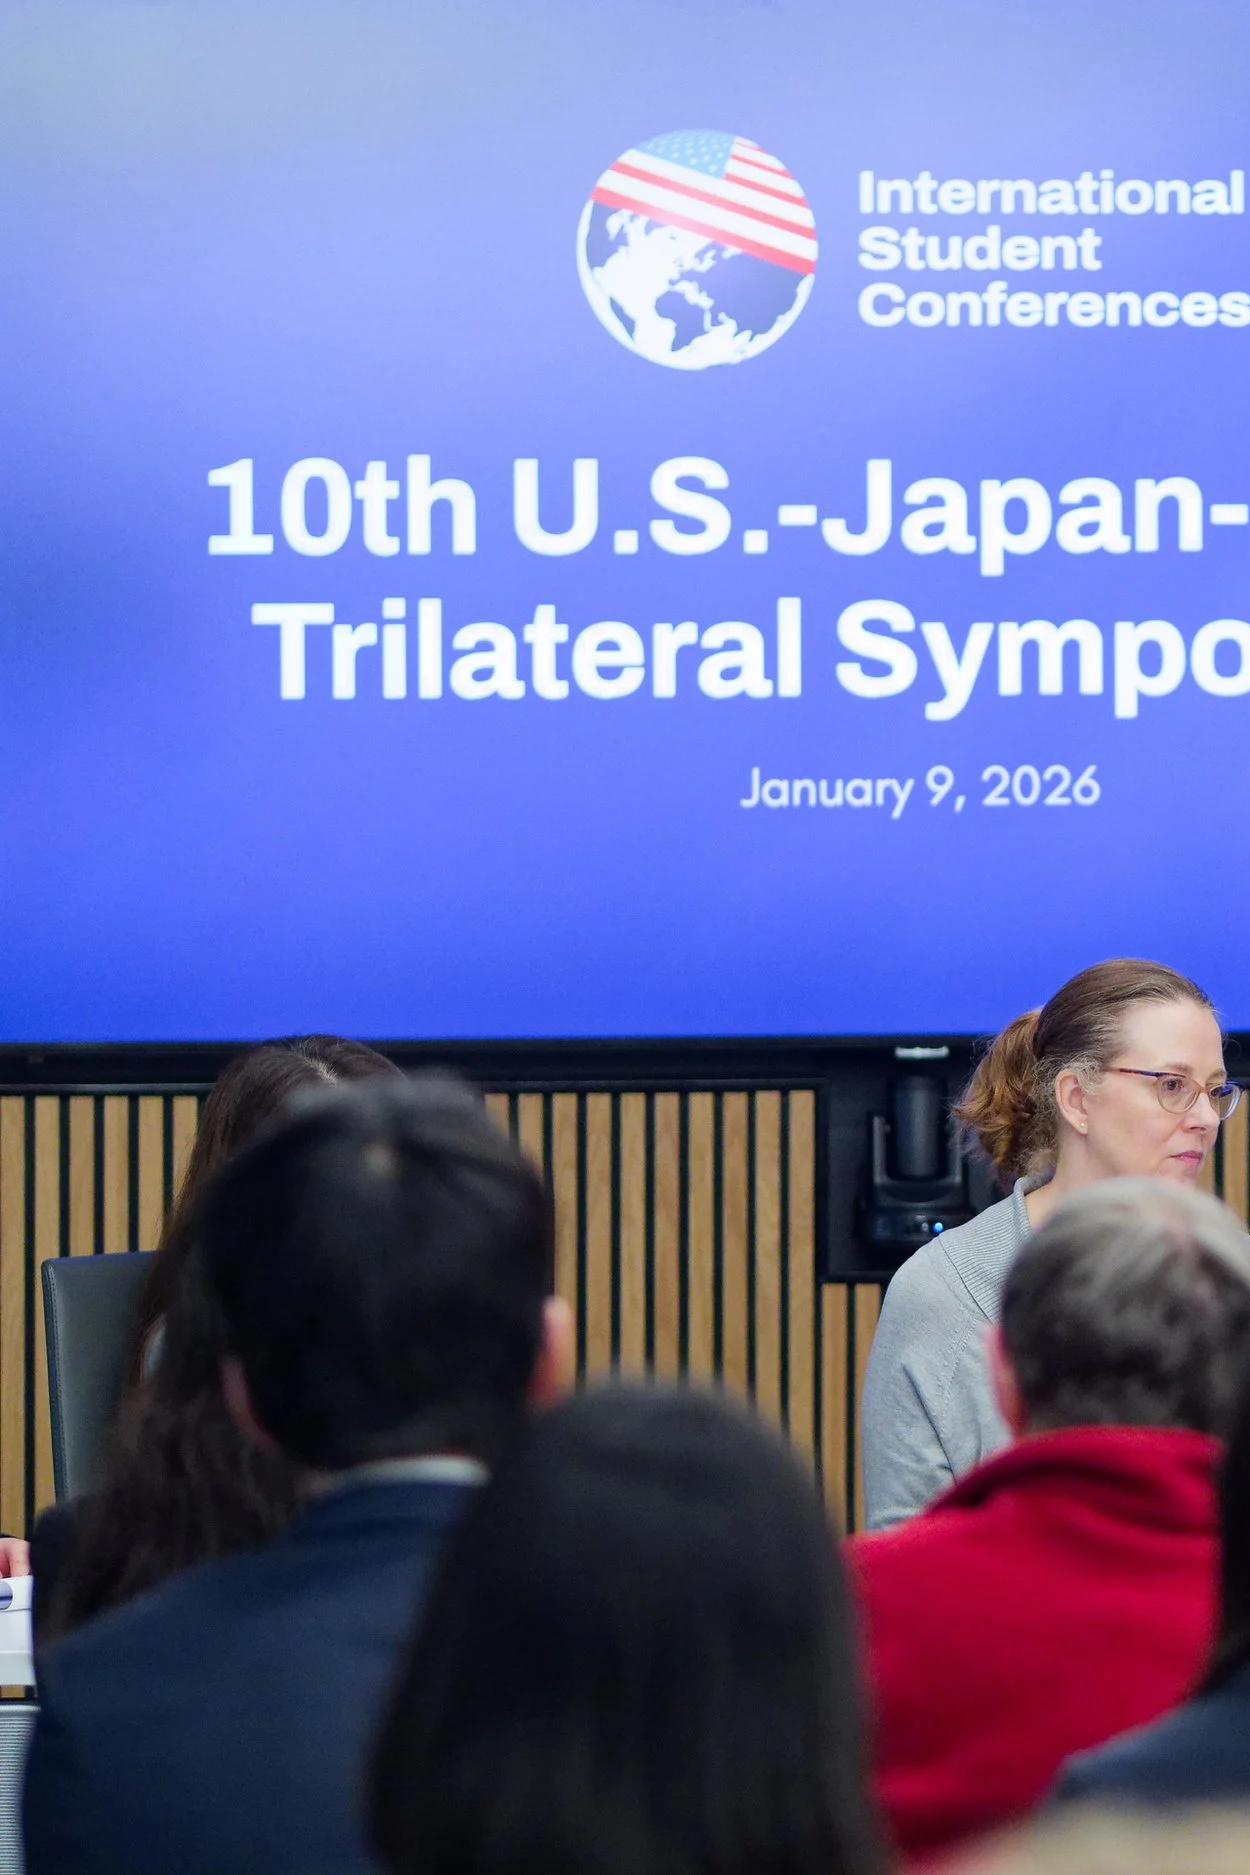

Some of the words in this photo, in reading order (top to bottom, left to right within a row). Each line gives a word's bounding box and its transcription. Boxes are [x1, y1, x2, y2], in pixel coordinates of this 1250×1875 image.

[859, 169, 1244, 214] International
[858, 225, 1102, 271] Student
[208, 454, 476, 556] 10th
[251, 597, 802, 700] Trilateral
[741, 766, 914, 819] January
[926, 765, 965, 811] 9,
[982, 764, 1101, 806] 2026
